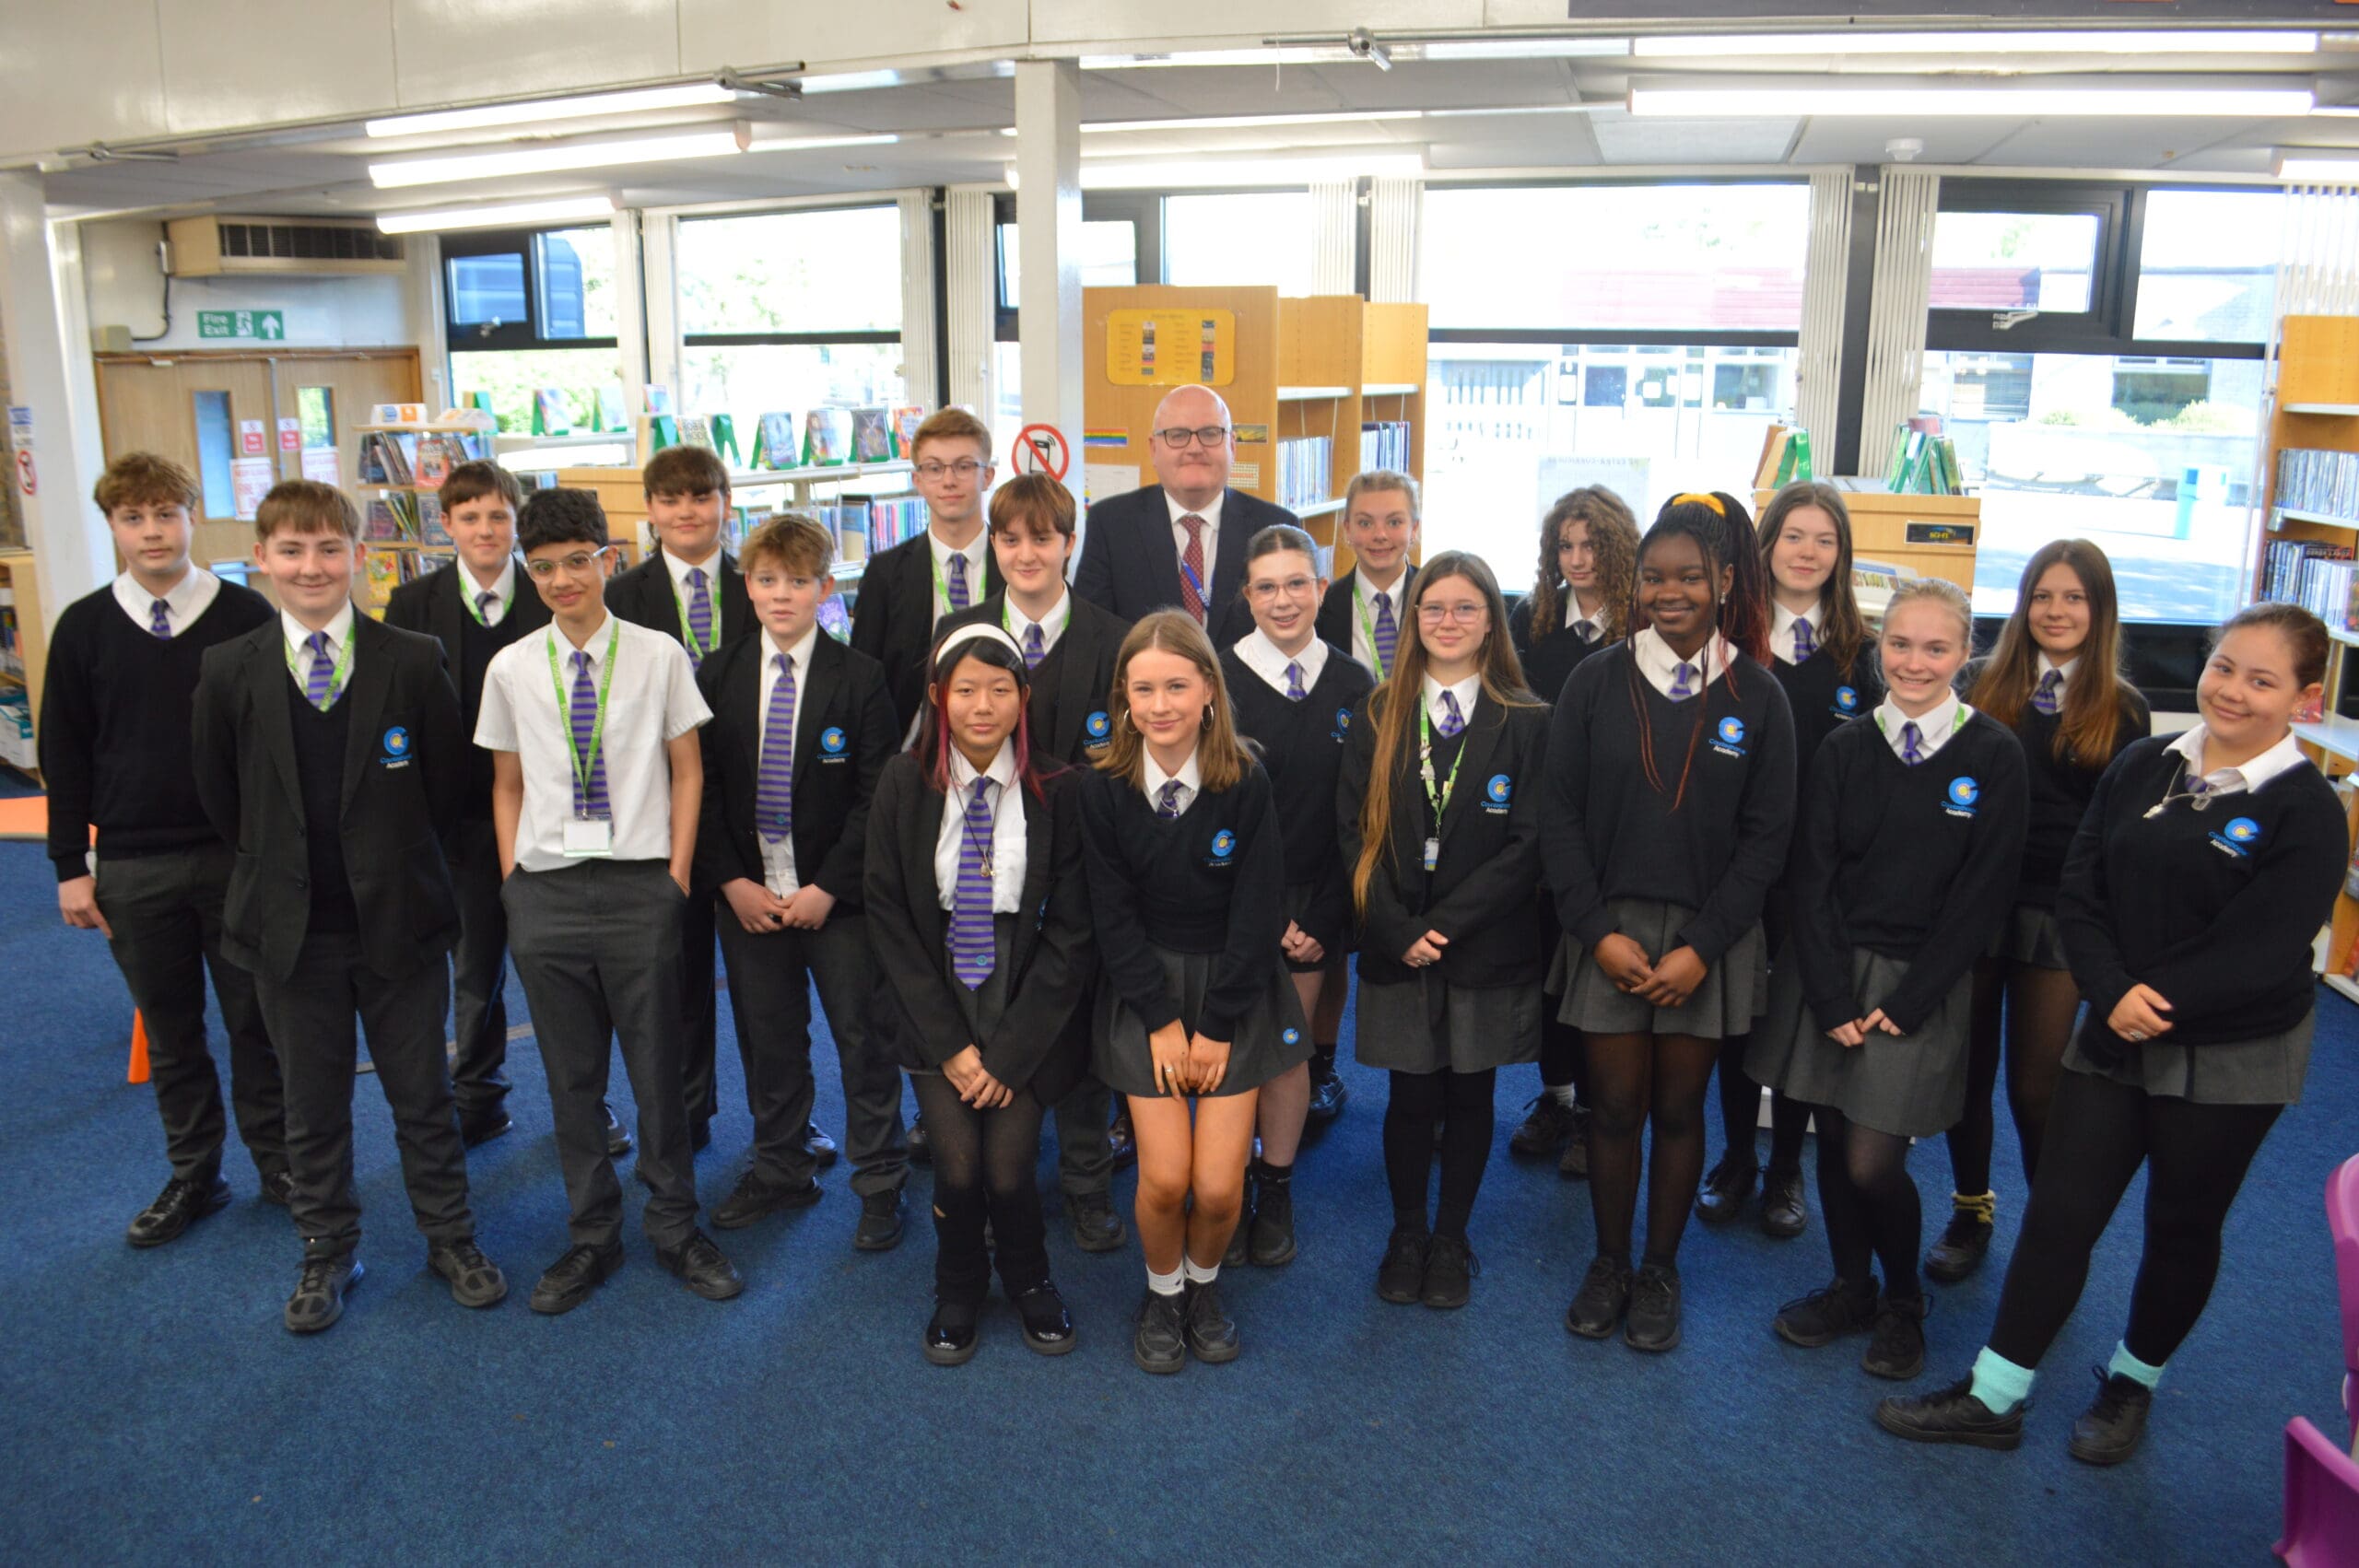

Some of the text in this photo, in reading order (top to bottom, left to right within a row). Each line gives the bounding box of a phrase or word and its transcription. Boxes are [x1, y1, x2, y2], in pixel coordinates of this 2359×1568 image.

[203, 313, 229, 324] Fire
[204, 324, 229, 336] Exit
[603, 655, 613, 689] STUDENT
[560, 703, 572, 737] STUDENT
[592, 704, 604, 738] STUDENT
